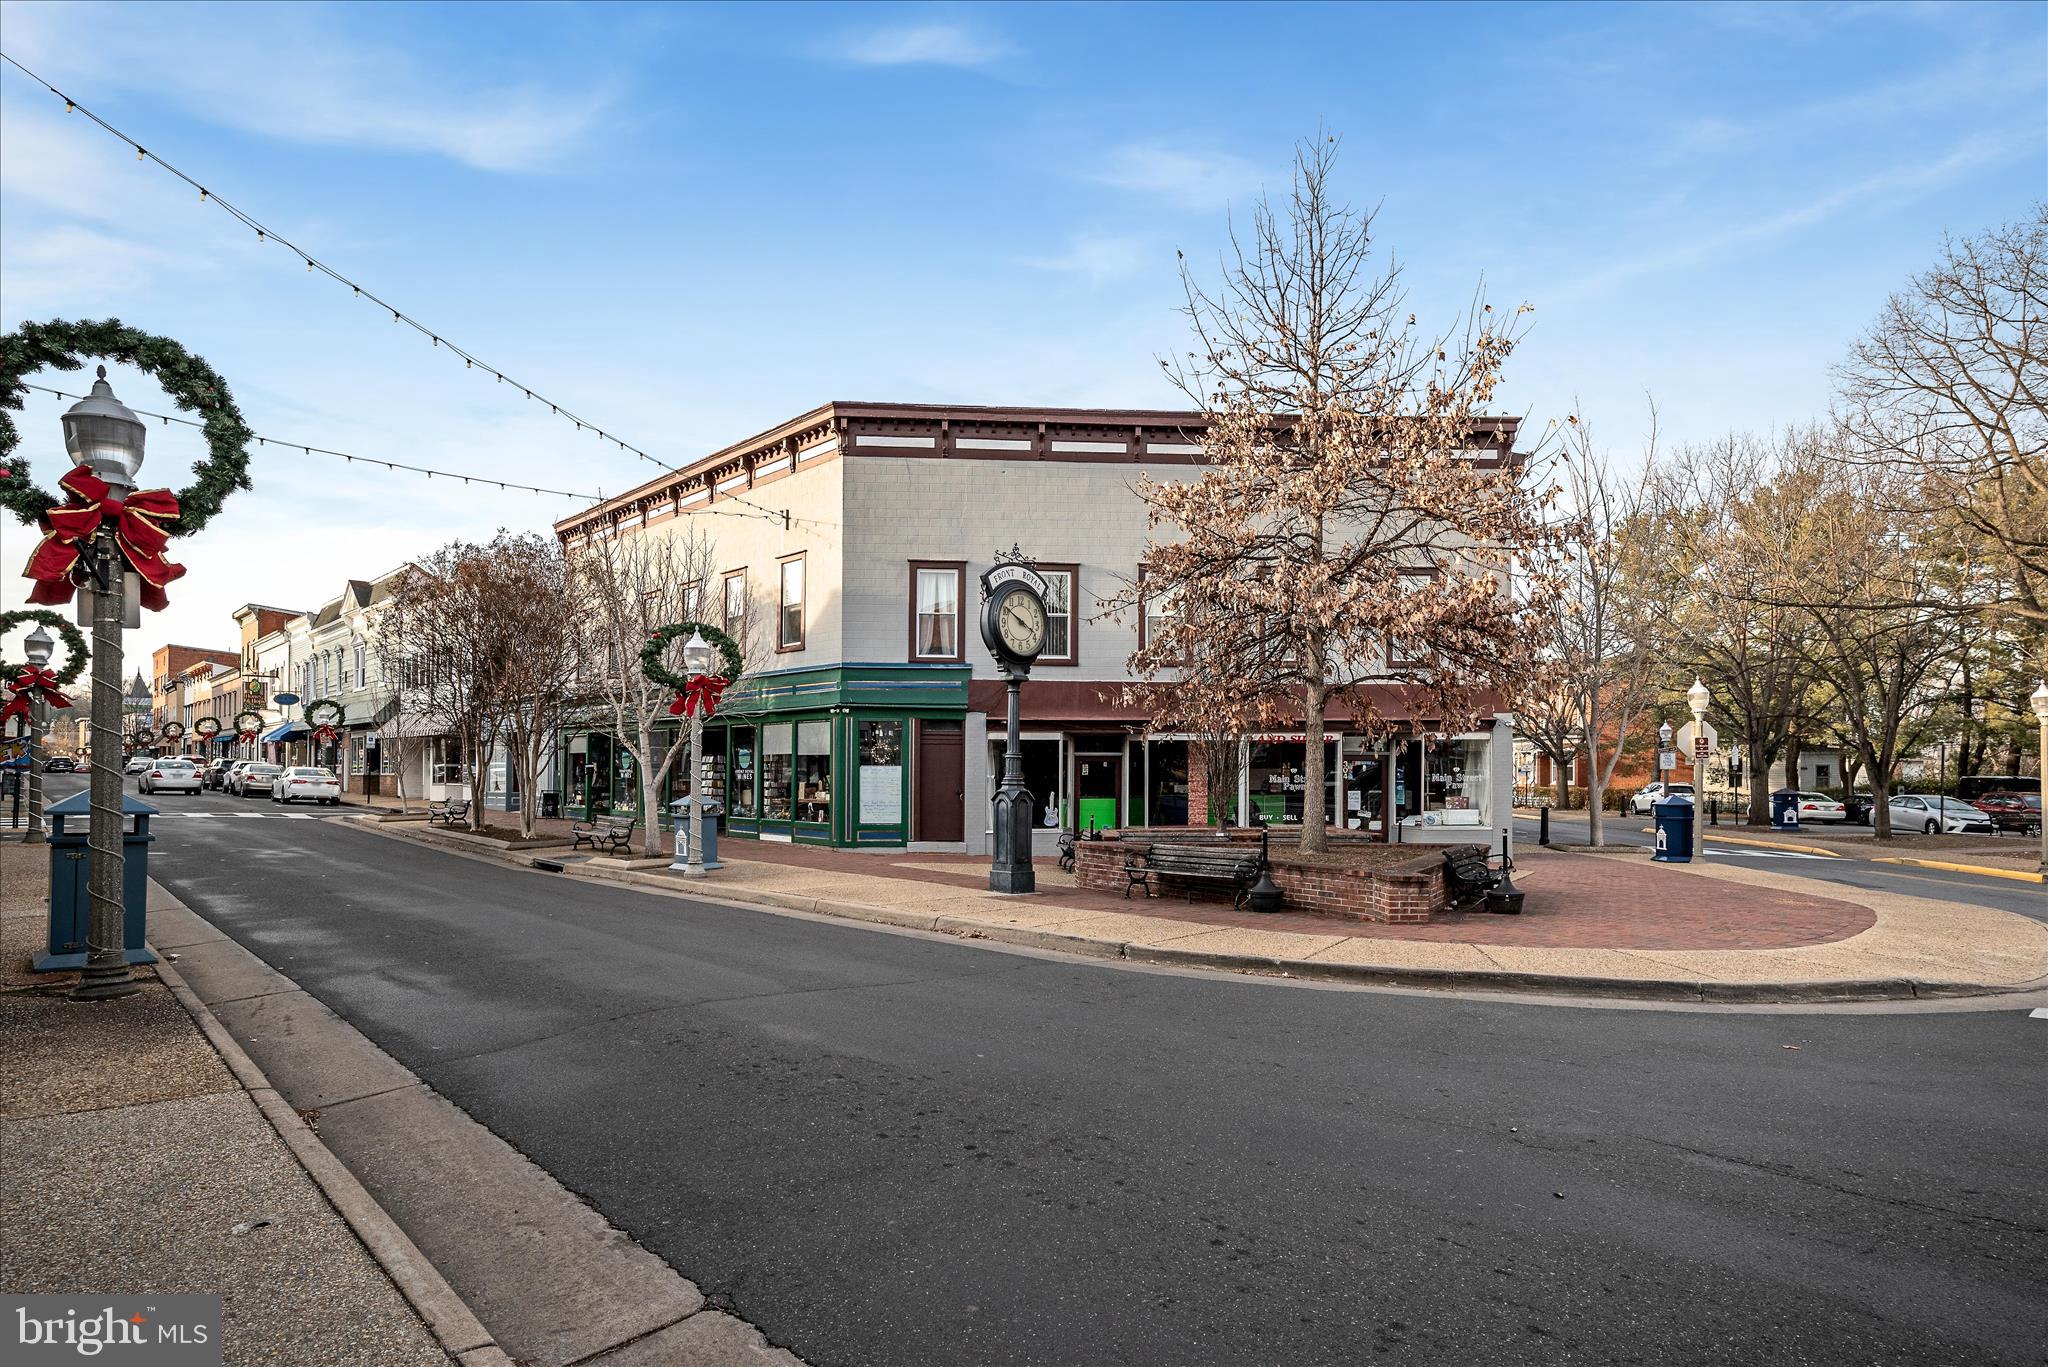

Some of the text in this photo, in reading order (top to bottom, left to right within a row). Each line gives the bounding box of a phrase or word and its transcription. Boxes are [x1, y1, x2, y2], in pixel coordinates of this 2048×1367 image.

[993, 568, 1041, 590] FRONT ROYAL
[1017, 596, 1024, 606] 12
[1268, 774, 1290, 783] Main
[1431, 773, 1482, 782] Main Street
[1446, 781, 1468, 790] Pawn
